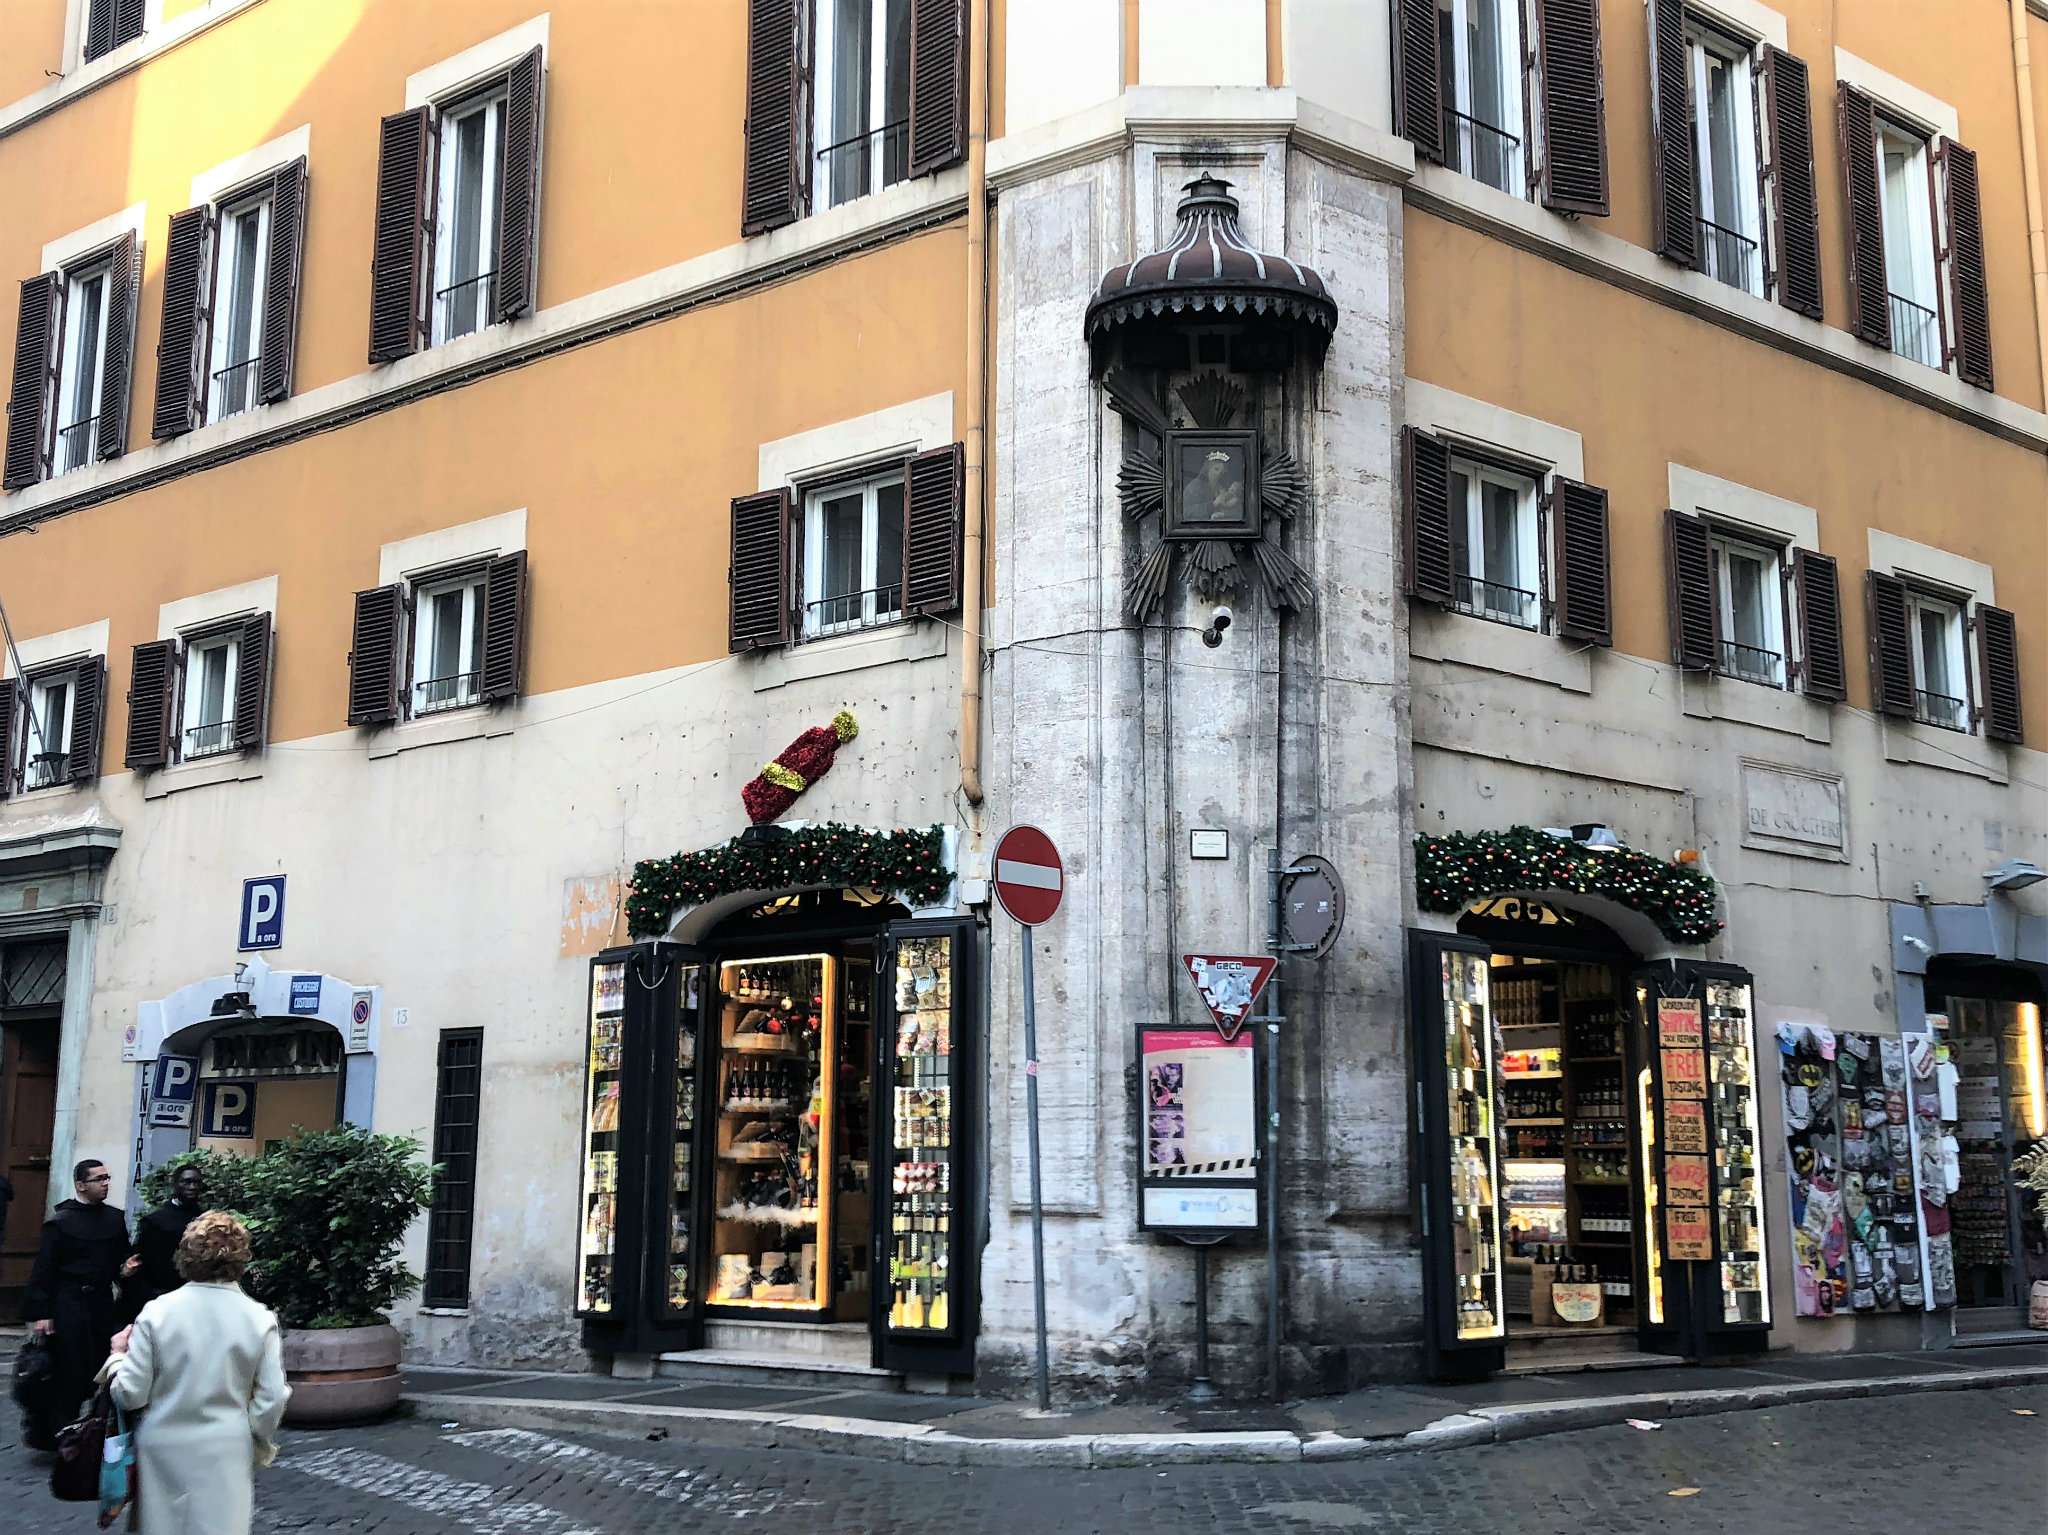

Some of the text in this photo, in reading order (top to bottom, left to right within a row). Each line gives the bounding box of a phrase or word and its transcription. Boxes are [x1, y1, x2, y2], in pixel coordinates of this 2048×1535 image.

[247, 884, 278, 944] P
[264, 934, 277, 942] ore
[162, 1059, 191, 1097] P
[1663, 1053, 1702, 1078] FREE
[167, 1104, 185, 1113] ore
[212, 1085, 247, 1131] P
